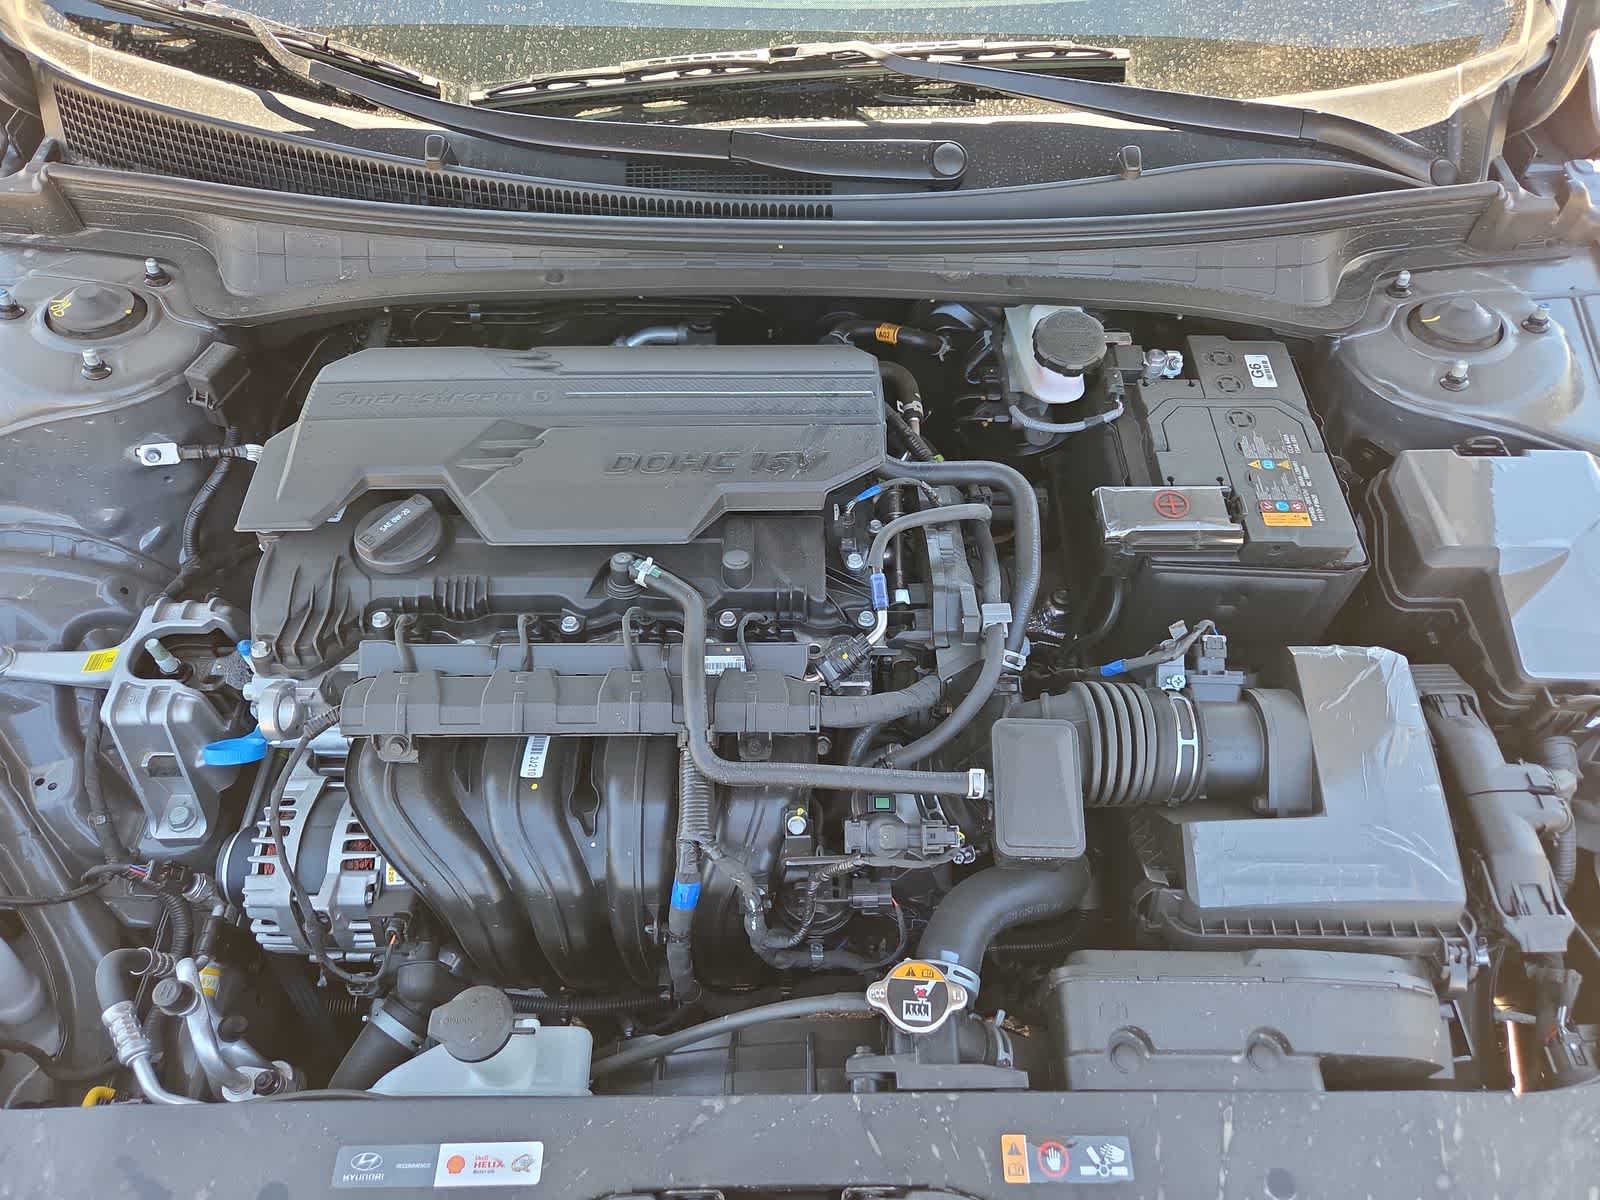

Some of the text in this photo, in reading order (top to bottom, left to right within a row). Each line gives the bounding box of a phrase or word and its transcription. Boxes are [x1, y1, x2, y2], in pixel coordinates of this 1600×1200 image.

[1250, 362, 1264, 379] G6
[603, 450, 743, 475] DOHC
[342, 1174, 385, 1182] HYUNDAI
